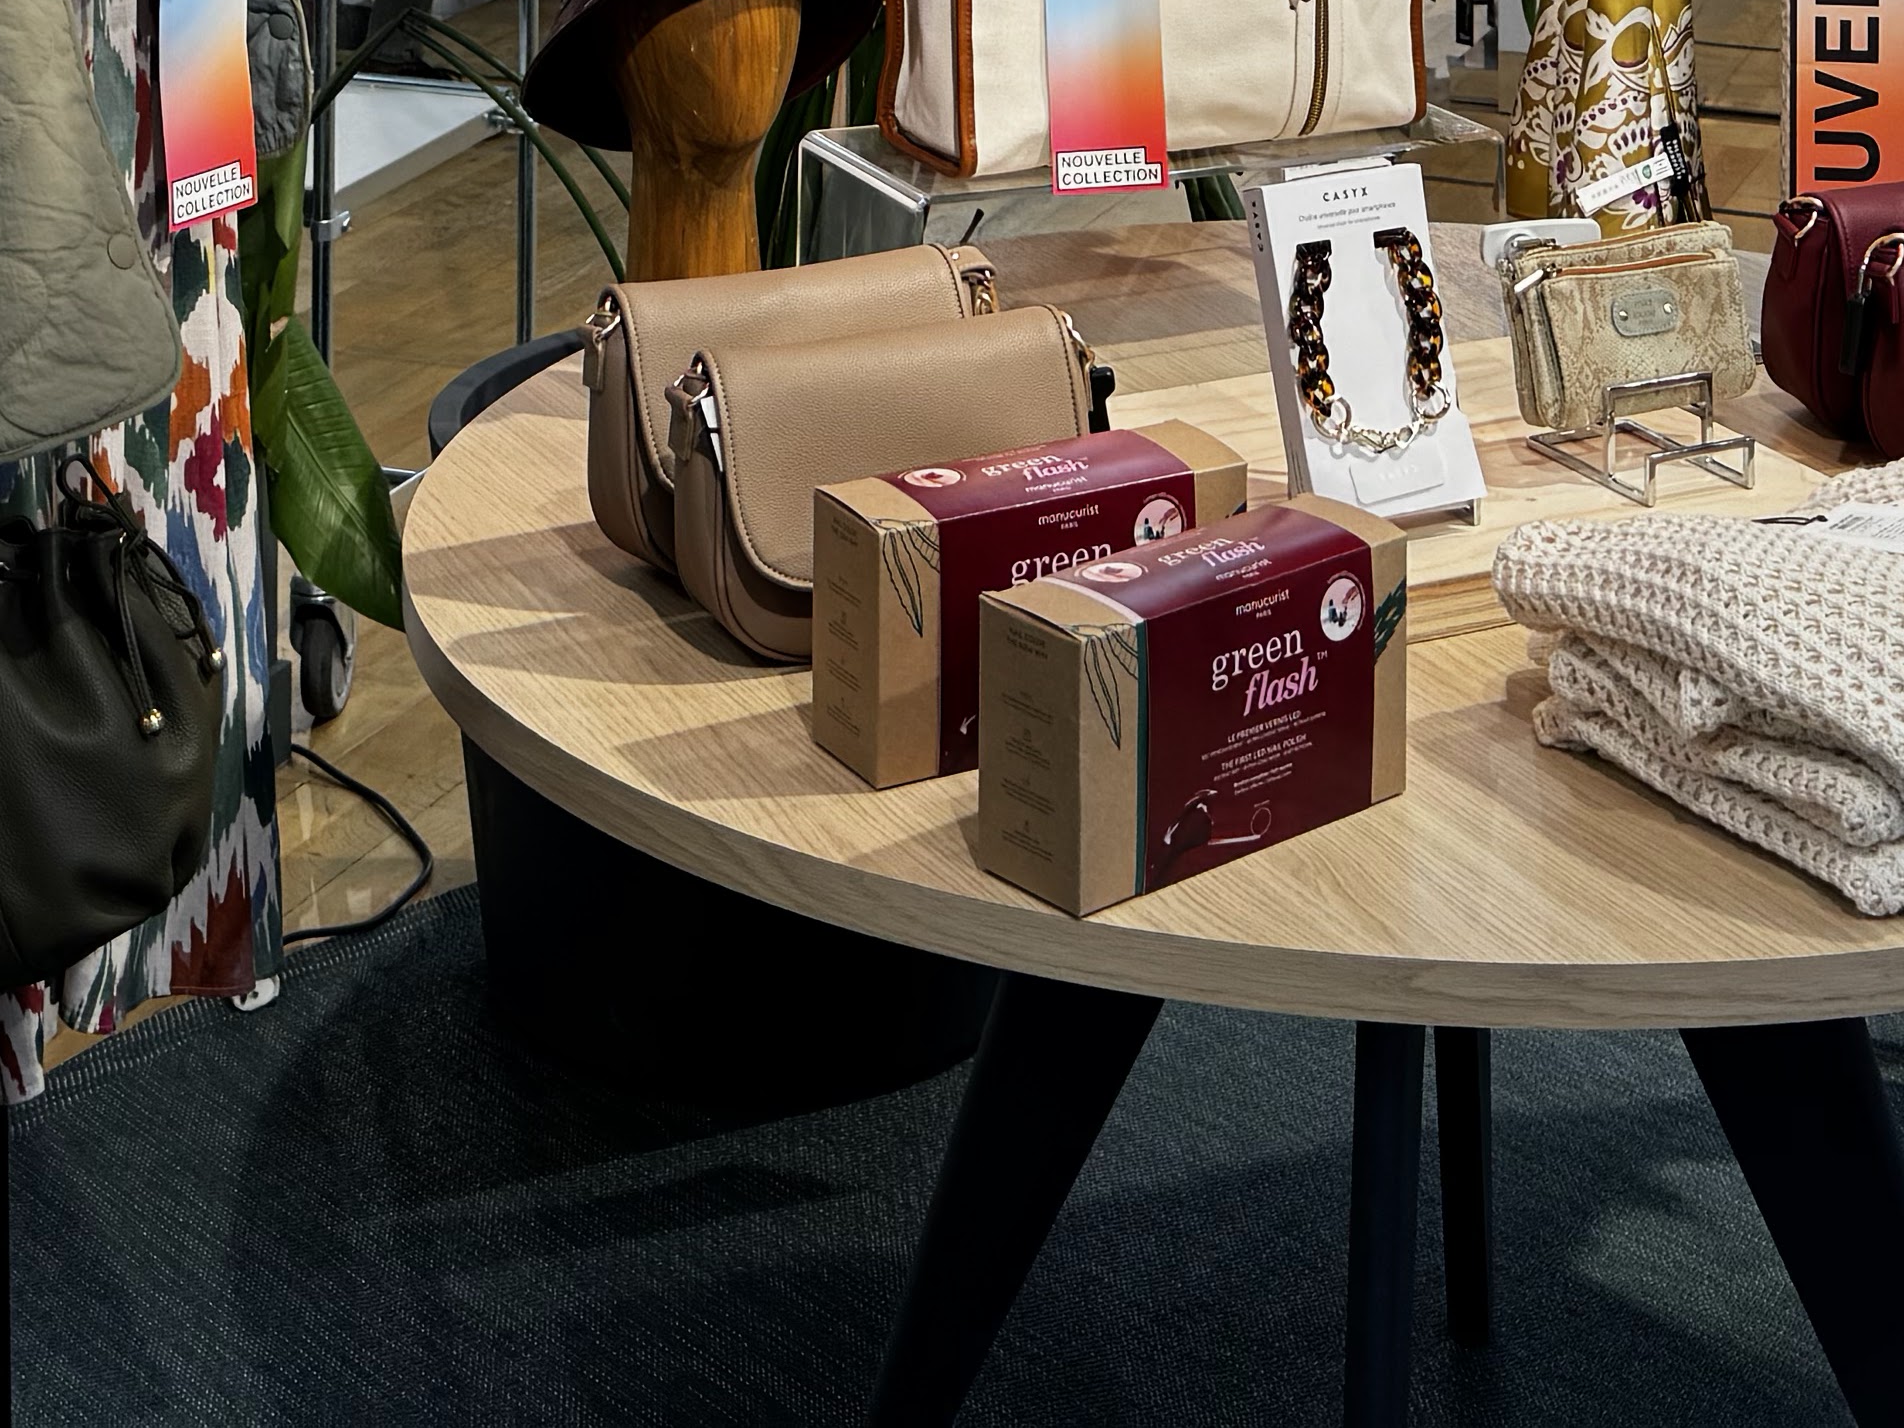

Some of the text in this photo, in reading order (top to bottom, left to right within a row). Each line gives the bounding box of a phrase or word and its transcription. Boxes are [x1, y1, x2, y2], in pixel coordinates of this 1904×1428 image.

[1061, 151, 1142, 168] NOUVELLE
[176, 167, 238, 200] NOUVELLE
[1062, 168, 1158, 186] COLLECTION
[177, 182, 250, 219] COLLECTION
[1322, 186, 1369, 202] CASYX
[981, 455, 1064, 477] green
[1023, 459, 1089, 481] flash
[1038, 503, 1100, 527] manucurist
[1158, 537, 1235, 566] green
[1202, 541, 1265, 567] flash
[1235, 588, 1290, 617] manucurist
[1212, 628, 1304, 692] green
[1242, 656, 1319, 717] flash
